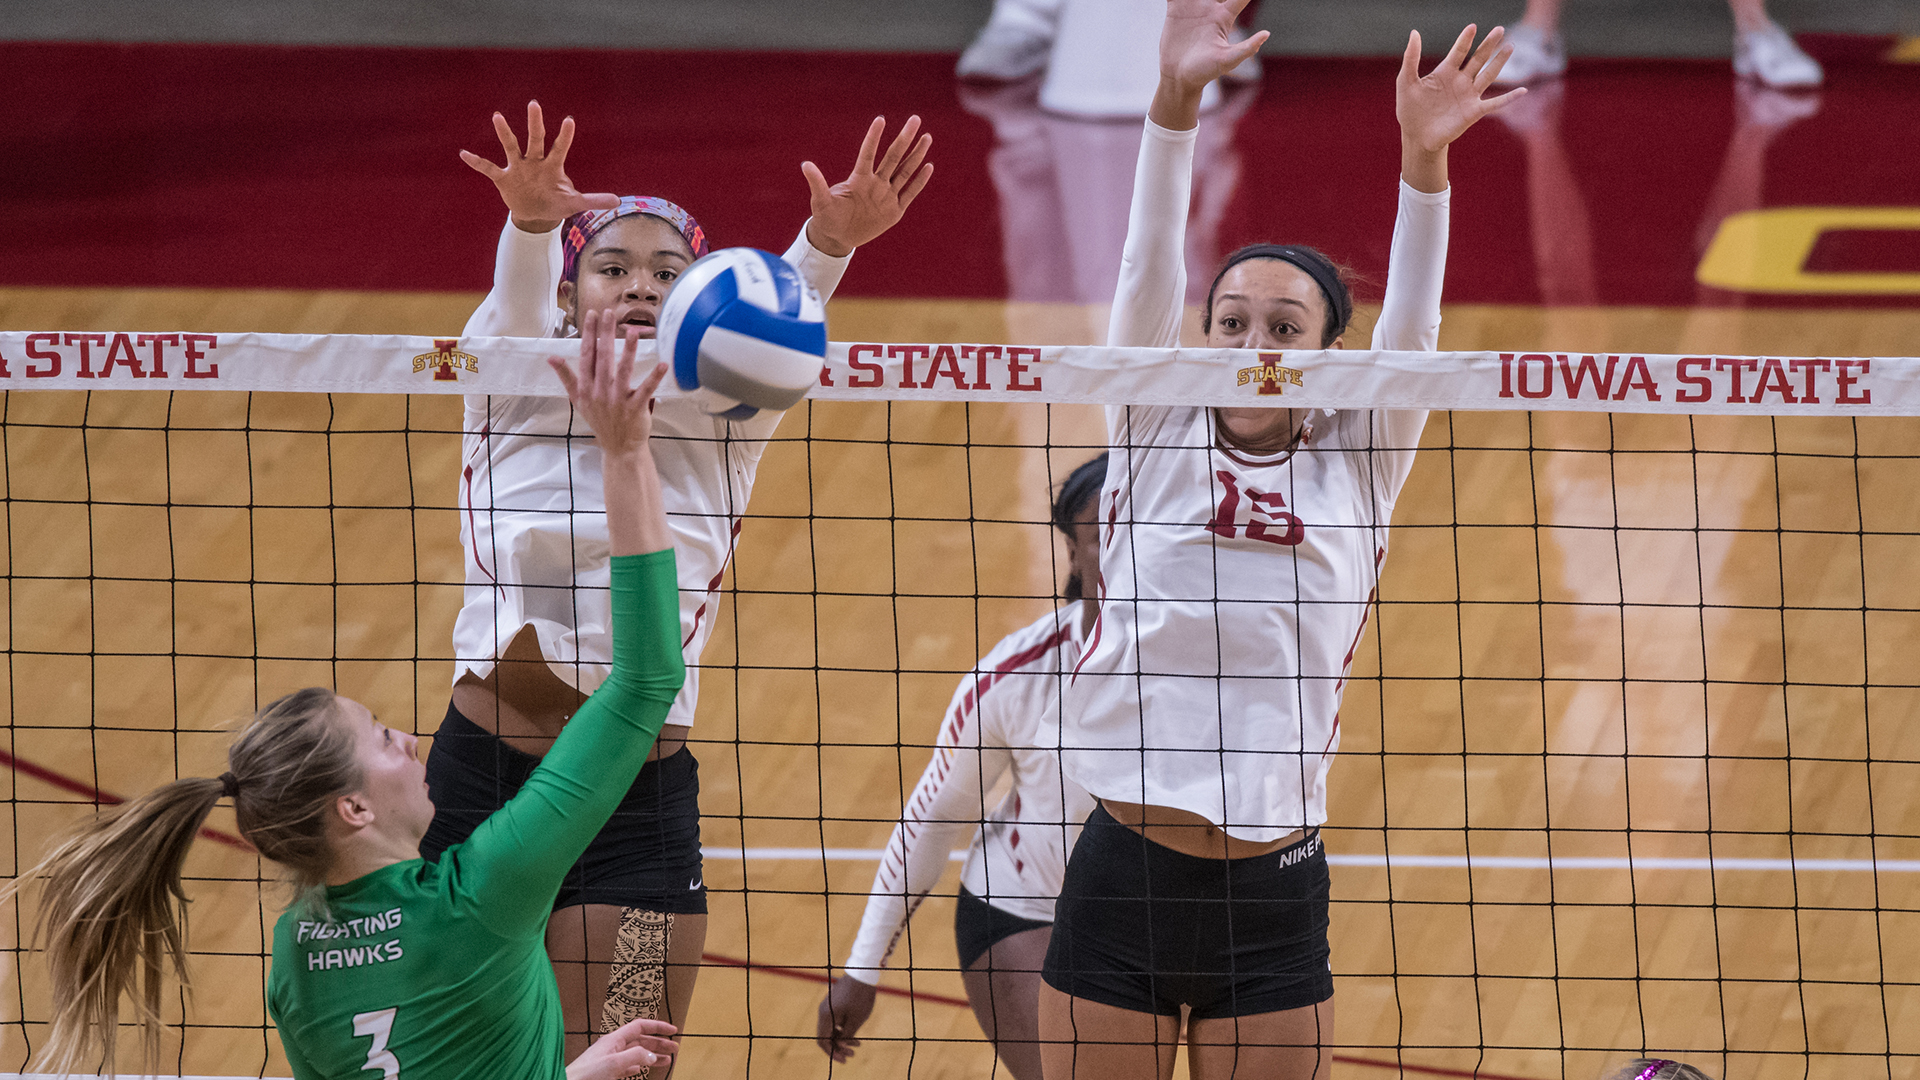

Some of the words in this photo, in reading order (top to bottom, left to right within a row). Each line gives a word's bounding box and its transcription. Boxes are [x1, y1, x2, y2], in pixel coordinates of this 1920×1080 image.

[25, 333, 219, 379] STATE
[412, 350, 479, 374] STATE
[848, 344, 1042, 392] STATE
[1236, 365, 1303, 387] STATE
[1498, 353, 1661, 402] IOWA
[1675, 357, 1871, 404] STATE
[1204, 469, 1305, 546] 15
[1279, 840, 1314, 869] NIKE
[297, 907, 402, 945] FIGHTING
[307, 939, 404, 971] HAWKS
[352, 1006, 400, 1080] 3
